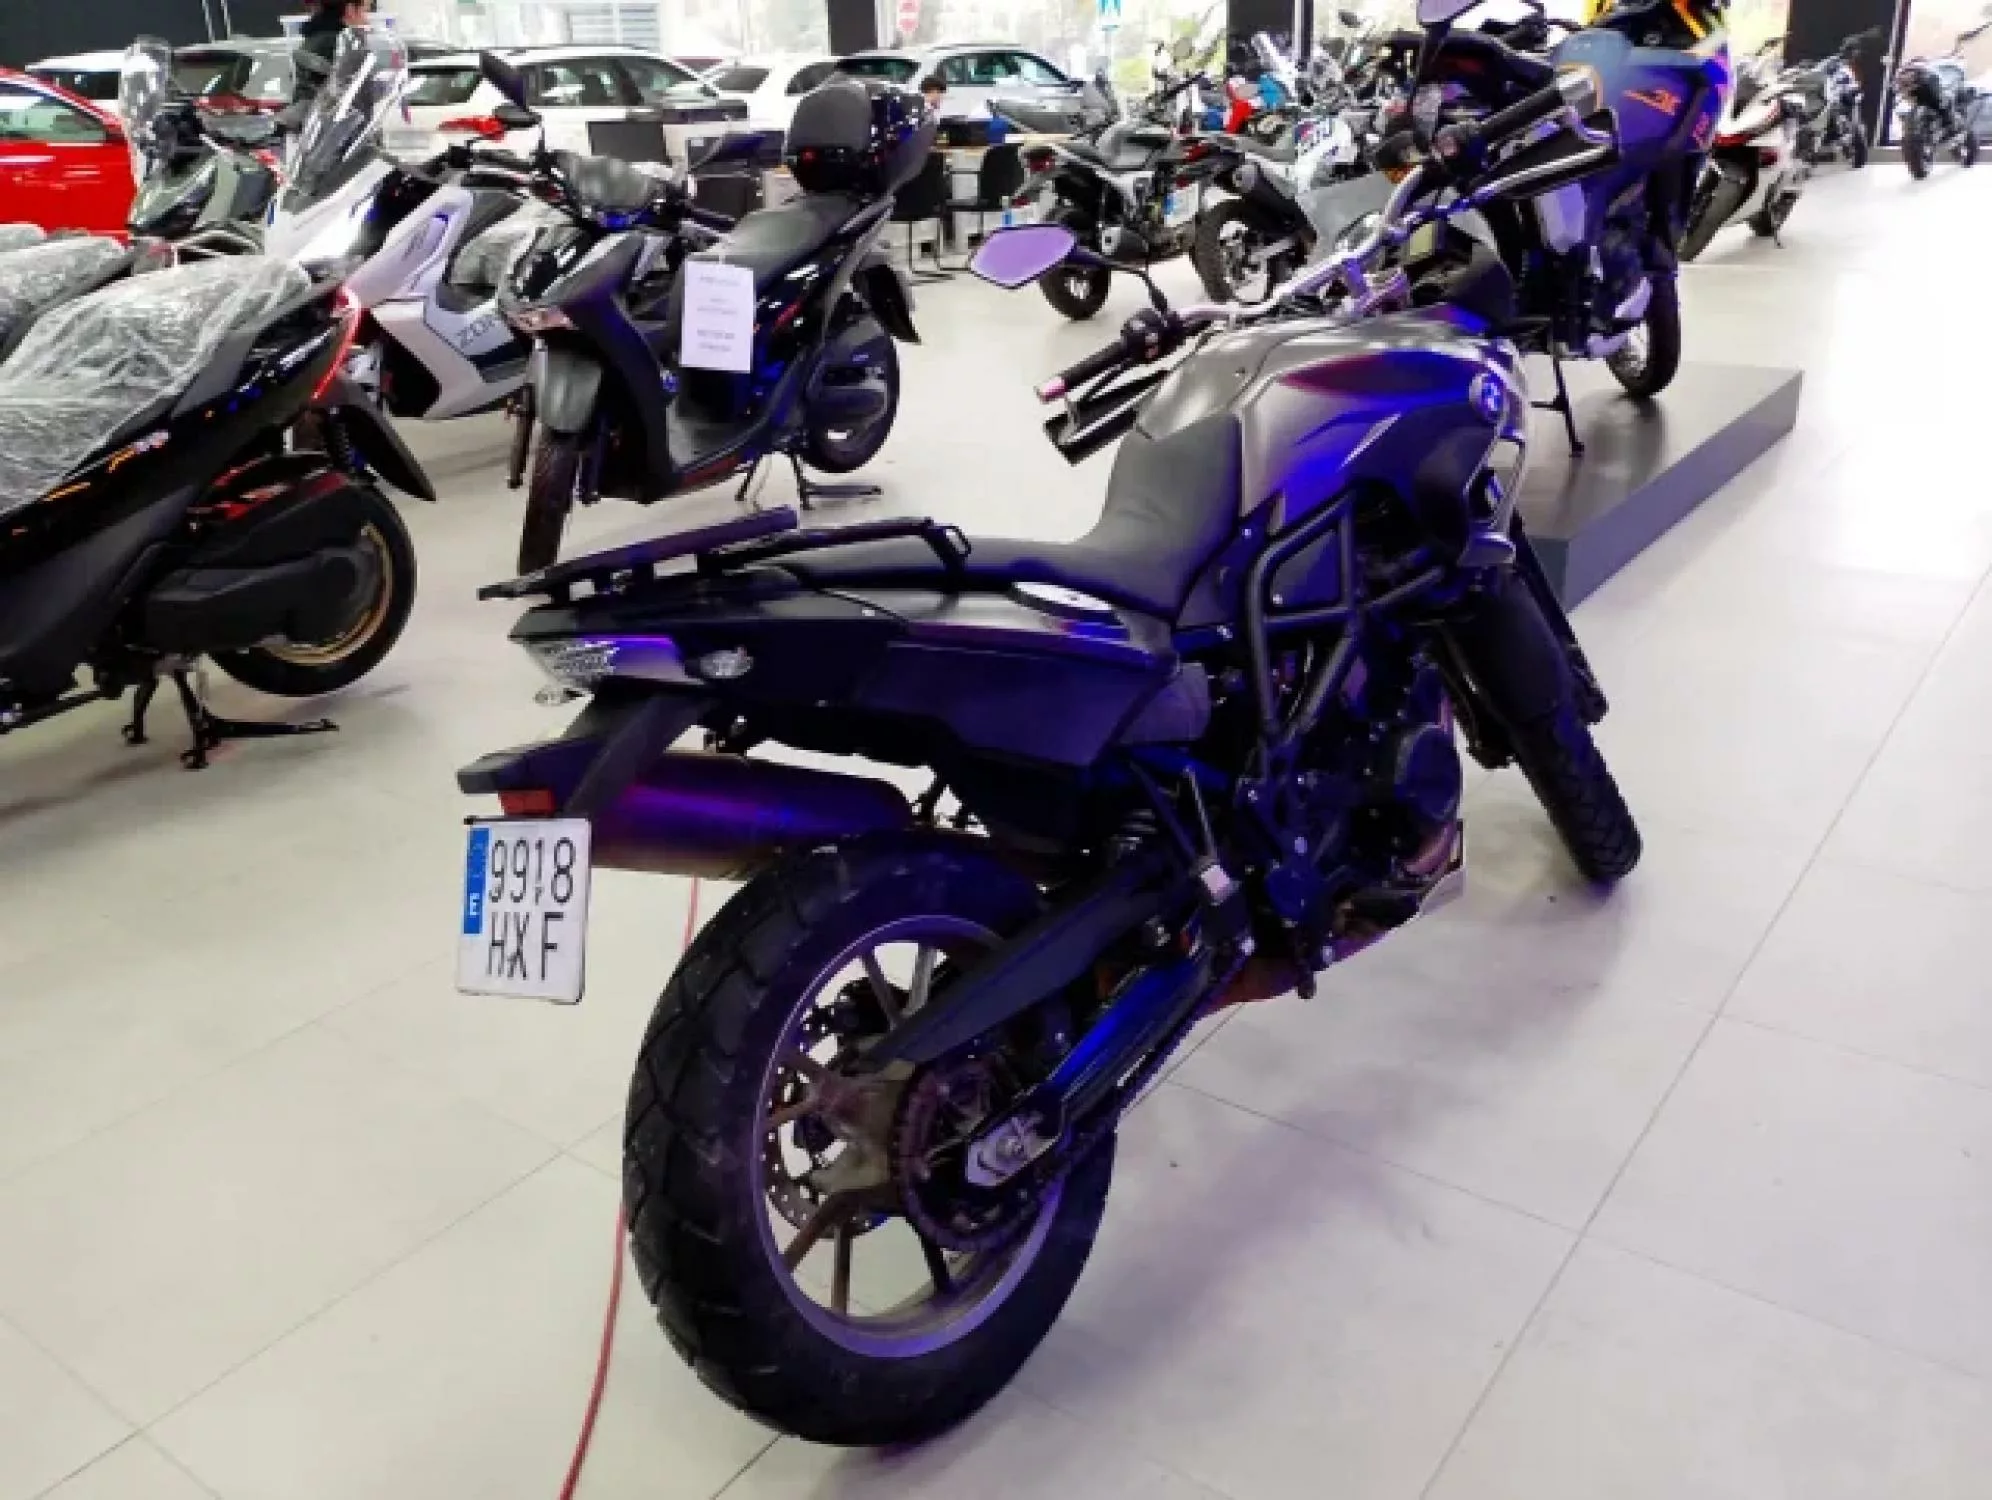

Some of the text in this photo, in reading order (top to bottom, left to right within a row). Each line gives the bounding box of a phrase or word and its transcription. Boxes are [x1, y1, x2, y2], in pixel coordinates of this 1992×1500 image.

[488, 836, 576, 904] 9918
[469, 893, 481, 917] E
[486, 911, 564, 981] HXF
